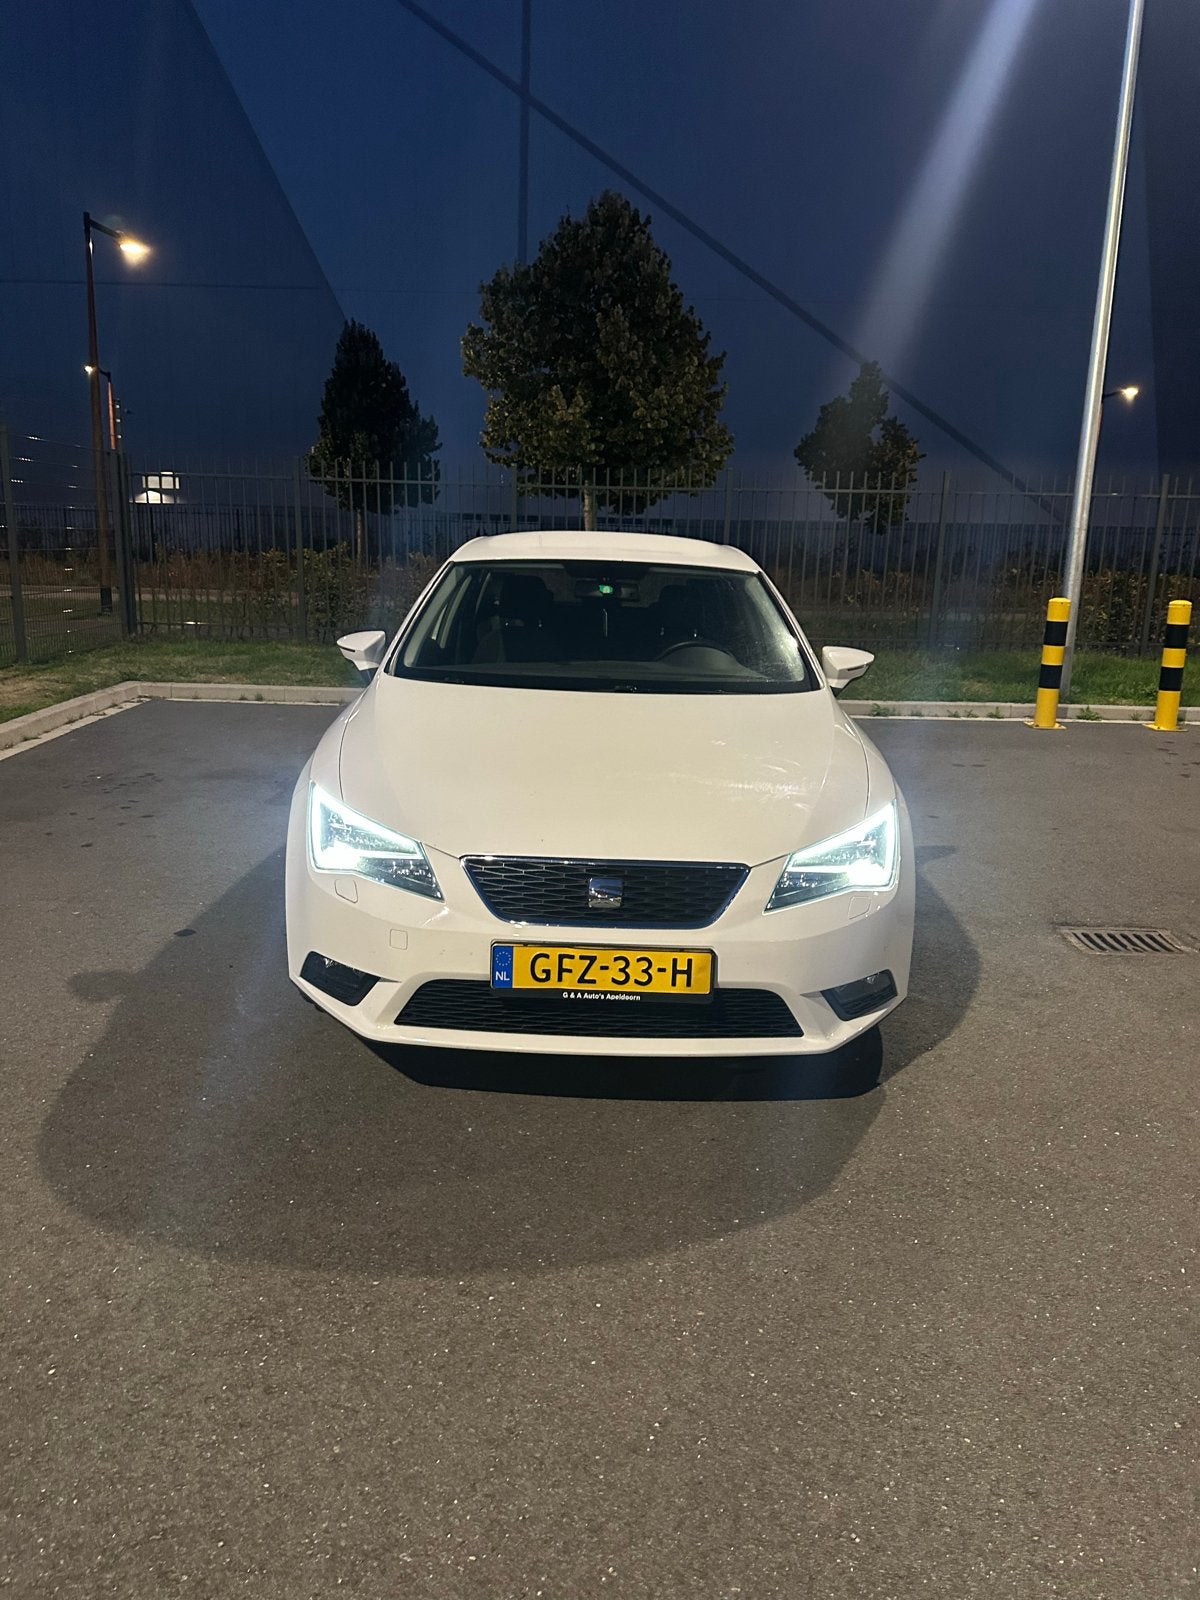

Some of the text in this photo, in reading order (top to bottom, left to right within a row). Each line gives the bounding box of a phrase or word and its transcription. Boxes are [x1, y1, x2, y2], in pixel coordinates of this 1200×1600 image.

[530, 952, 693, 987] GFZ-33-H
[495, 971, 510, 981] NL
[605, 993, 641, 1001] Apeldoorn
